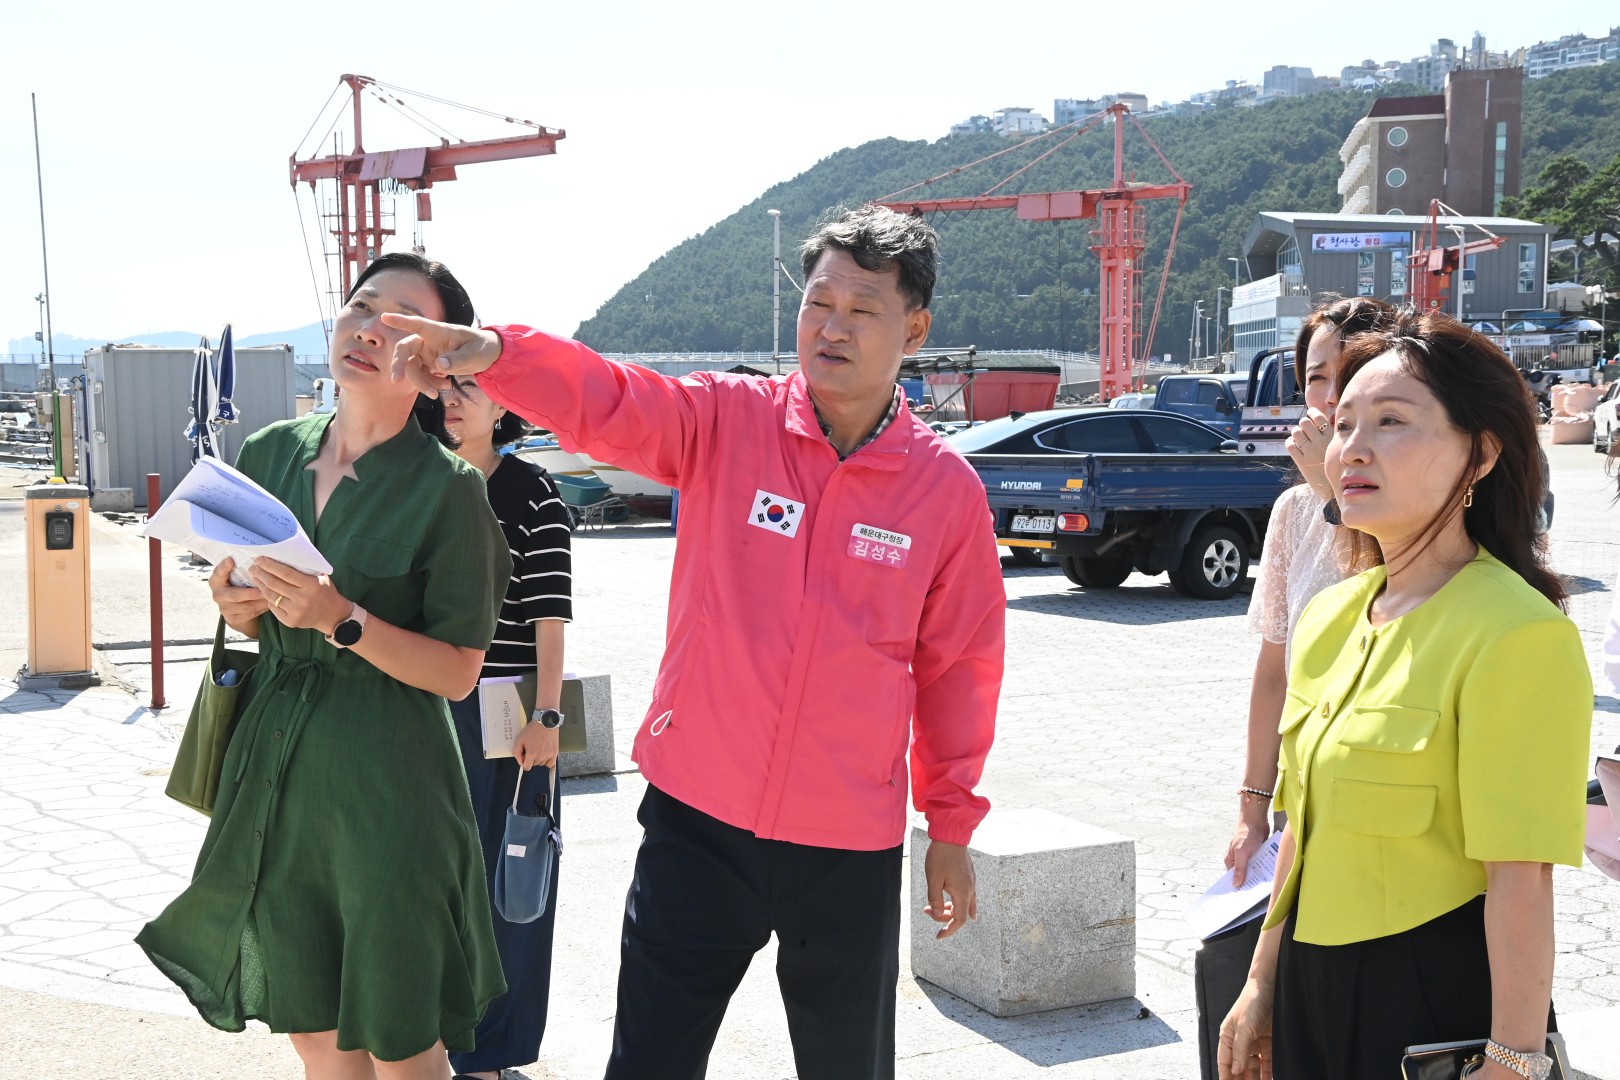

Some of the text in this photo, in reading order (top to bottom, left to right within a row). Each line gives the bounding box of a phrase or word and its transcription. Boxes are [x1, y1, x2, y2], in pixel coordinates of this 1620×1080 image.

[1365, 237, 1380, 246] 횟집
[1001, 481, 1042, 490] HYUNDAI
[1032, 518, 1052, 530] 0113
[860, 528, 903, 544] 해운대구청장
[855, 541, 901, 564] 김성수
